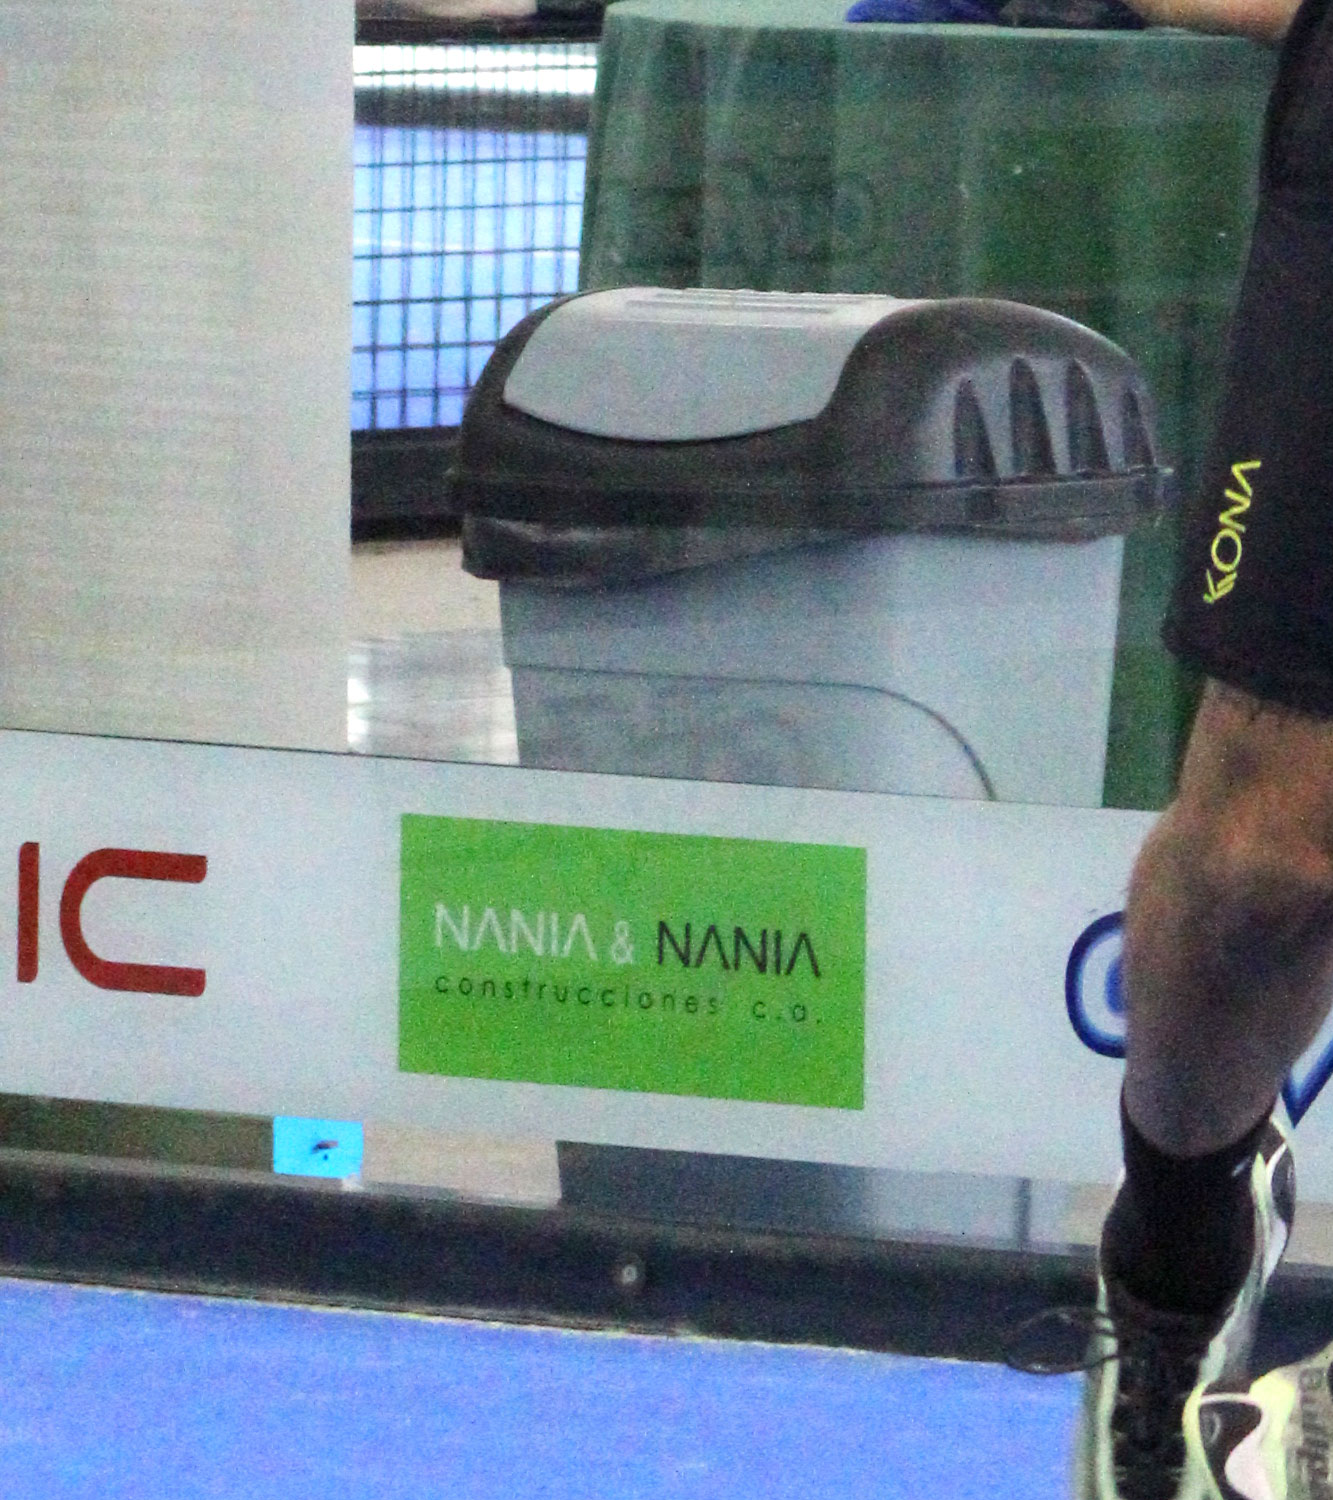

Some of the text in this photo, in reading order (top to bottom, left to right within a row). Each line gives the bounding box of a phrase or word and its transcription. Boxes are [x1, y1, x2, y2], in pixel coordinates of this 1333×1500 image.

[1203, 460, 1262, 605] KONA
[434, 903, 821, 979] NANIA & NANIA
[434, 972, 823, 1026] construcciones c.a.
